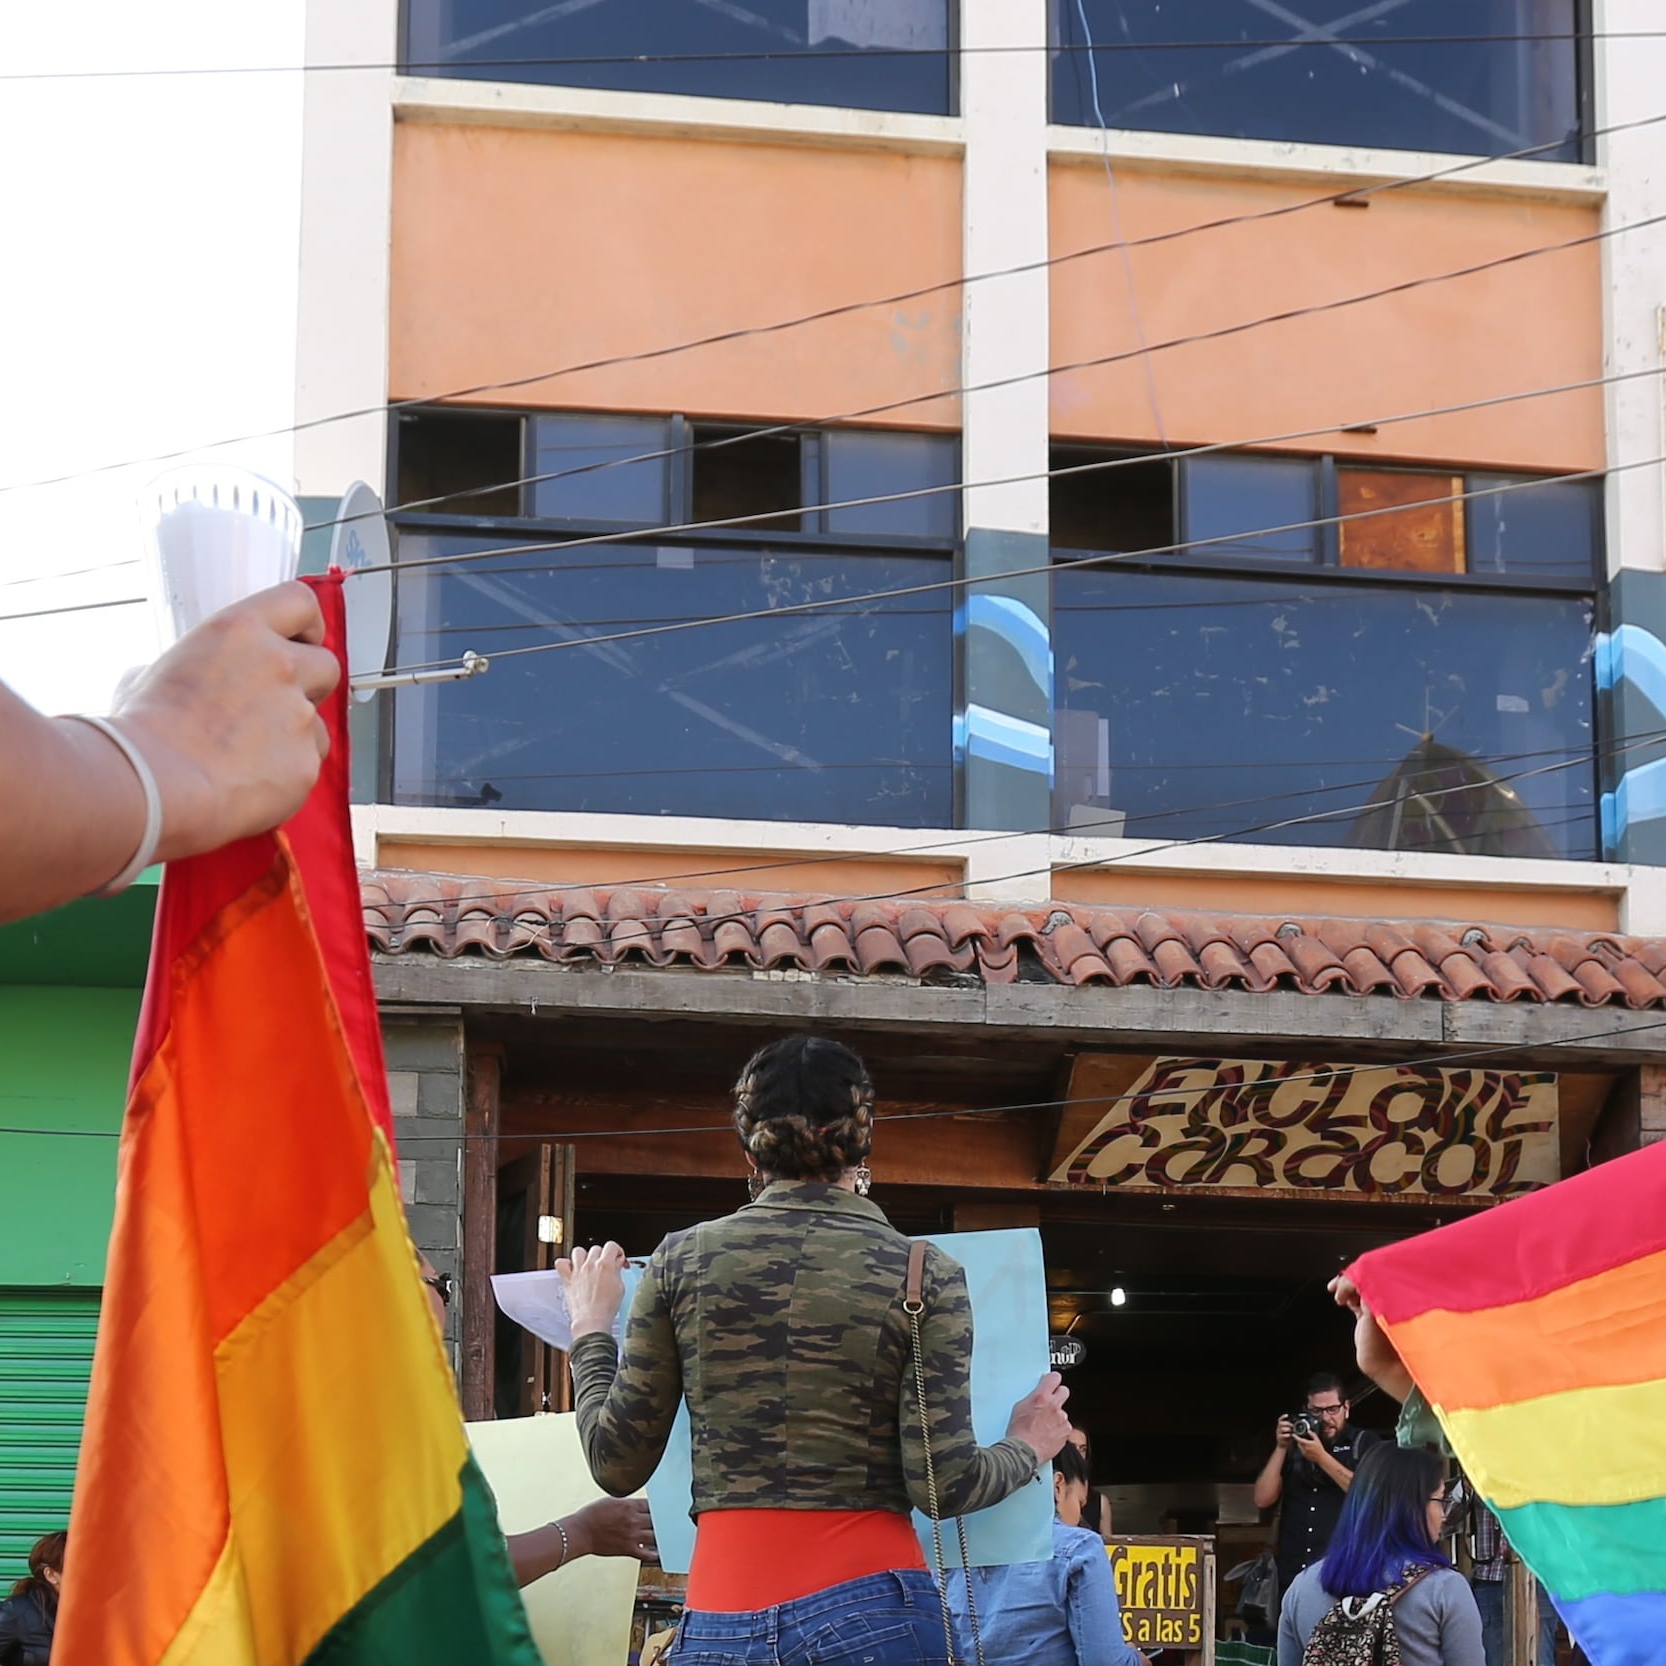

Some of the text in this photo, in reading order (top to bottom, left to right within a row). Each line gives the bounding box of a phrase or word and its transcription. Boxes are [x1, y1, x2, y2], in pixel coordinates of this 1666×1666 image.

[1111, 1546, 1196, 1609] Gratis
[1138, 1619, 1150, 1642] a
[1156, 1613, 1183, 1643] las
[1189, 1614, 1201, 1643] 5
